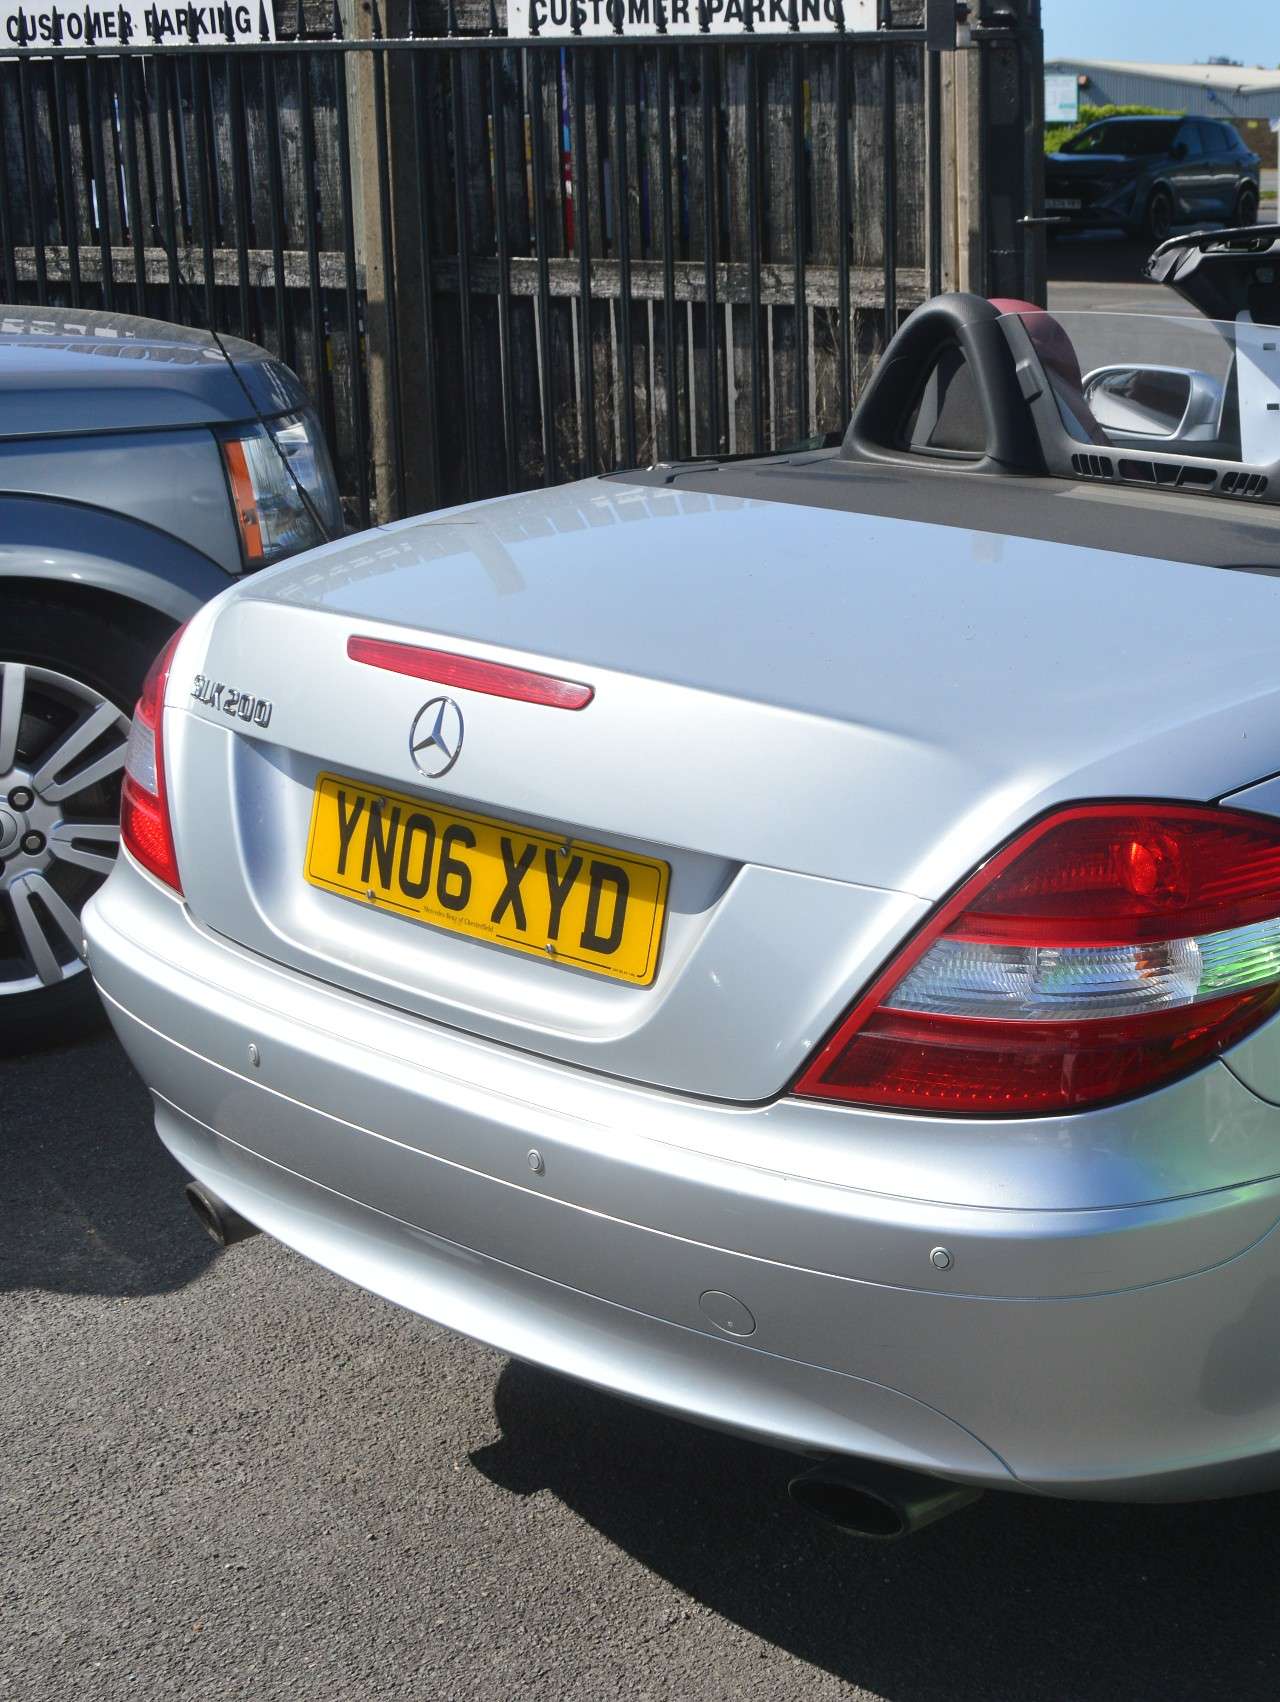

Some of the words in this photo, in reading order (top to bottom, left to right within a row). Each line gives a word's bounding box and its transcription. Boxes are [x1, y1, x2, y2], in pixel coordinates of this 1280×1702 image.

[6, 11, 134, 42] CUSTOMER
[144, 6, 252, 37] PARKING
[530, 0, 690, 26] CUSTOMER
[223, 688, 272, 729] 200
[337, 790, 477, 912] YN06
[490, 837, 630, 955] XYD
